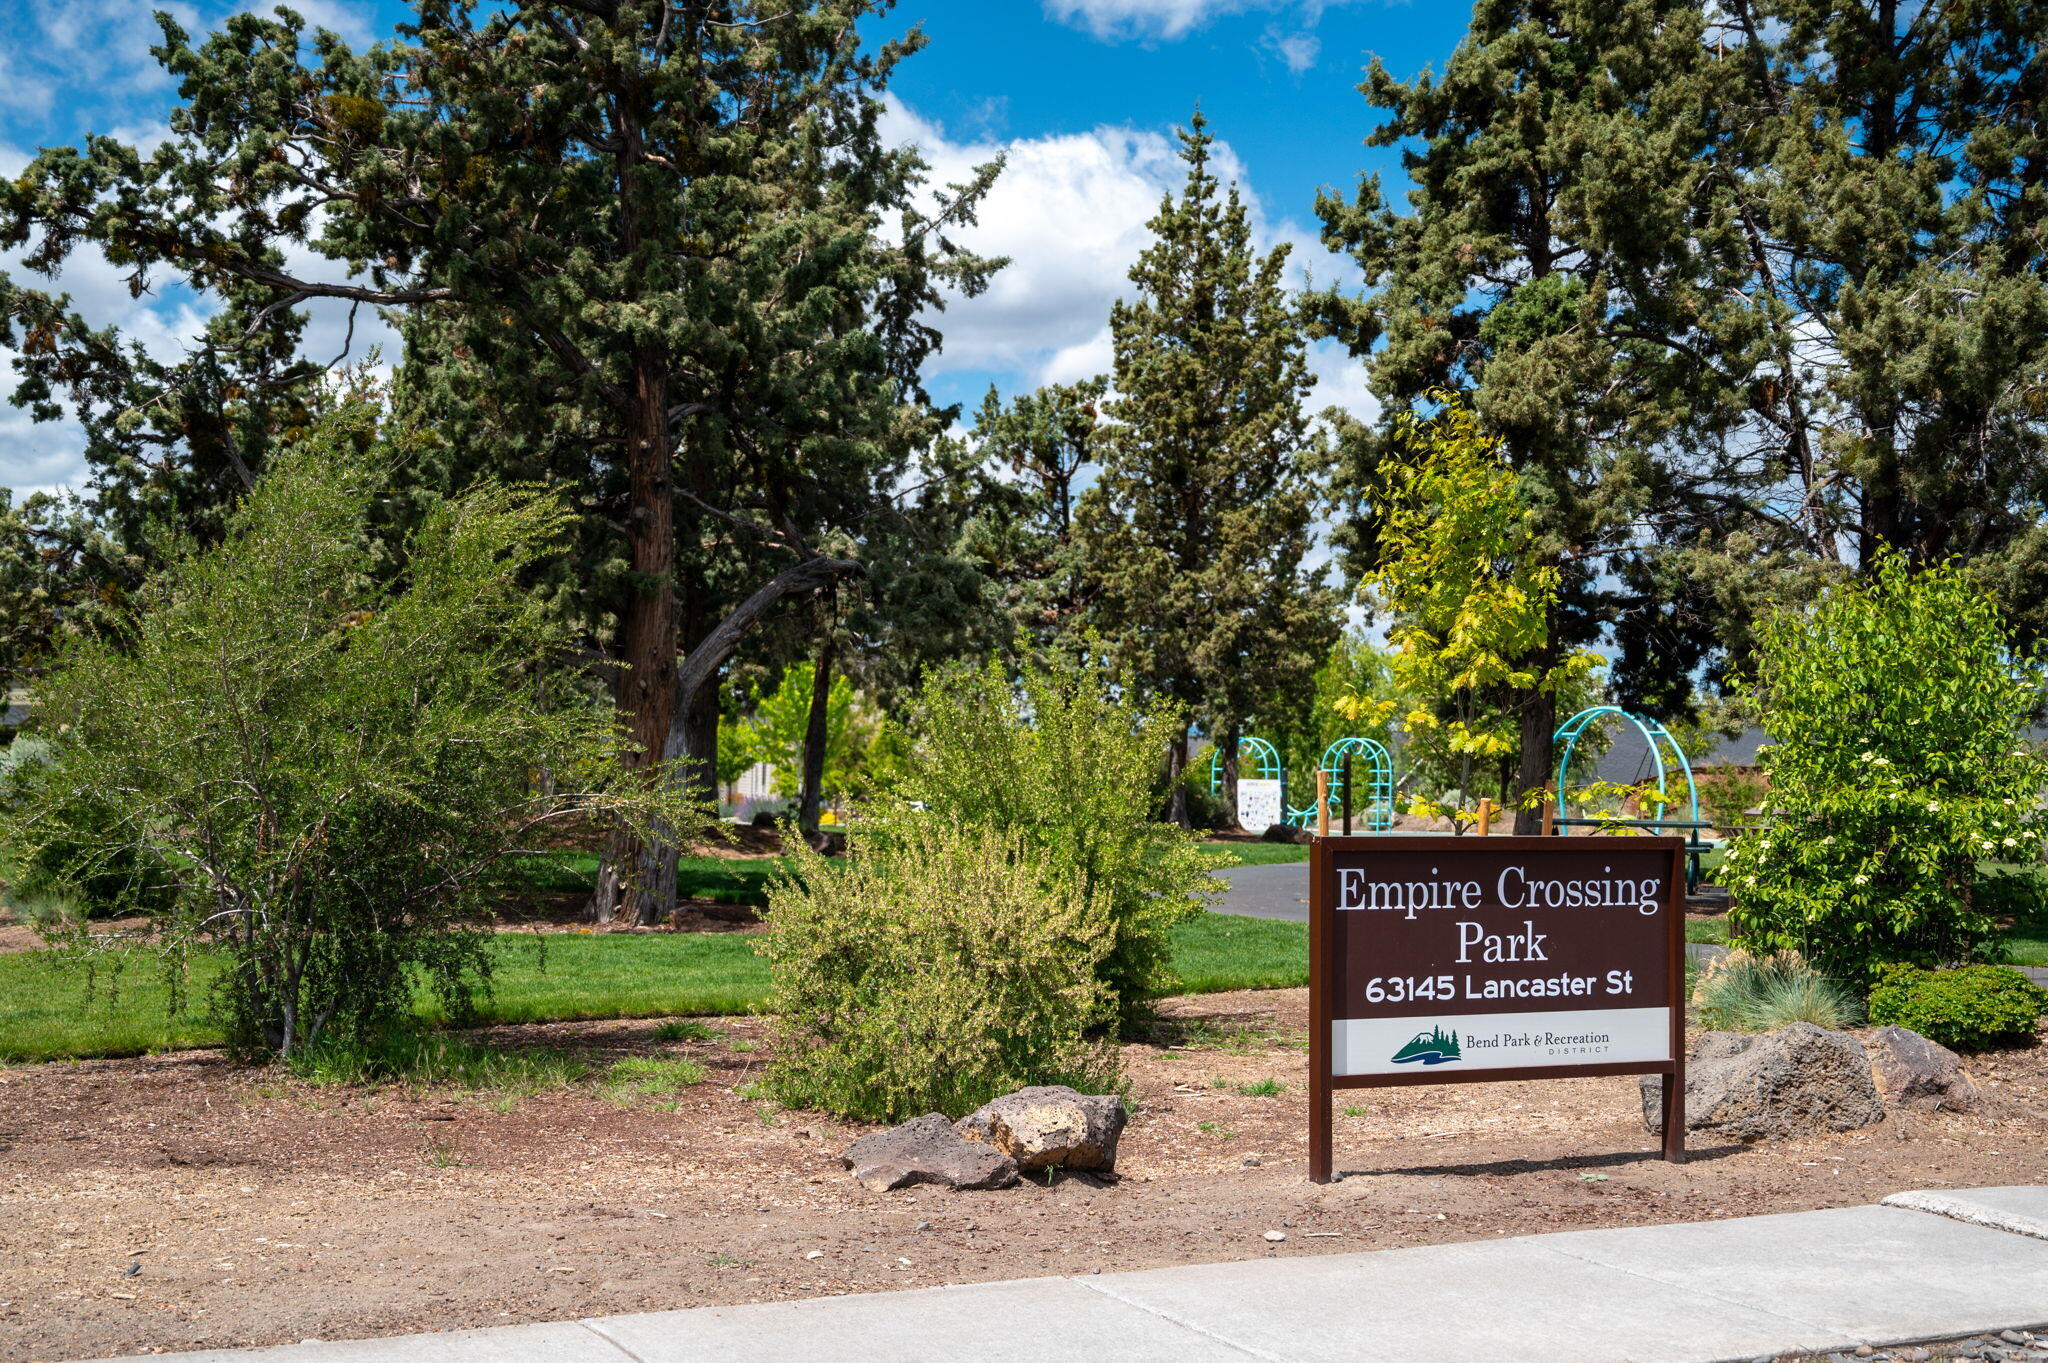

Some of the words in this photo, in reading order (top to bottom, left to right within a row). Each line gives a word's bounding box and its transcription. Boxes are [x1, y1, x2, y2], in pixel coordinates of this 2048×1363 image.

[1336, 868, 1482, 920] Empire
[1498, 866, 1660, 915] Crossing
[1455, 921, 1548, 963] Park
[1366, 976, 1455, 1003] 63145
[1466, 972, 1597, 999] Lancaster
[1606, 970, 1632, 994] St
[1466, 1035, 1498, 1049] Bend
[1503, 1033, 1530, 1047] Park
[1534, 1034, 1542, 1046] &
[1545, 1032, 1609, 1045] Recreation
[1549, 1046, 1609, 1055] DISTRICT
